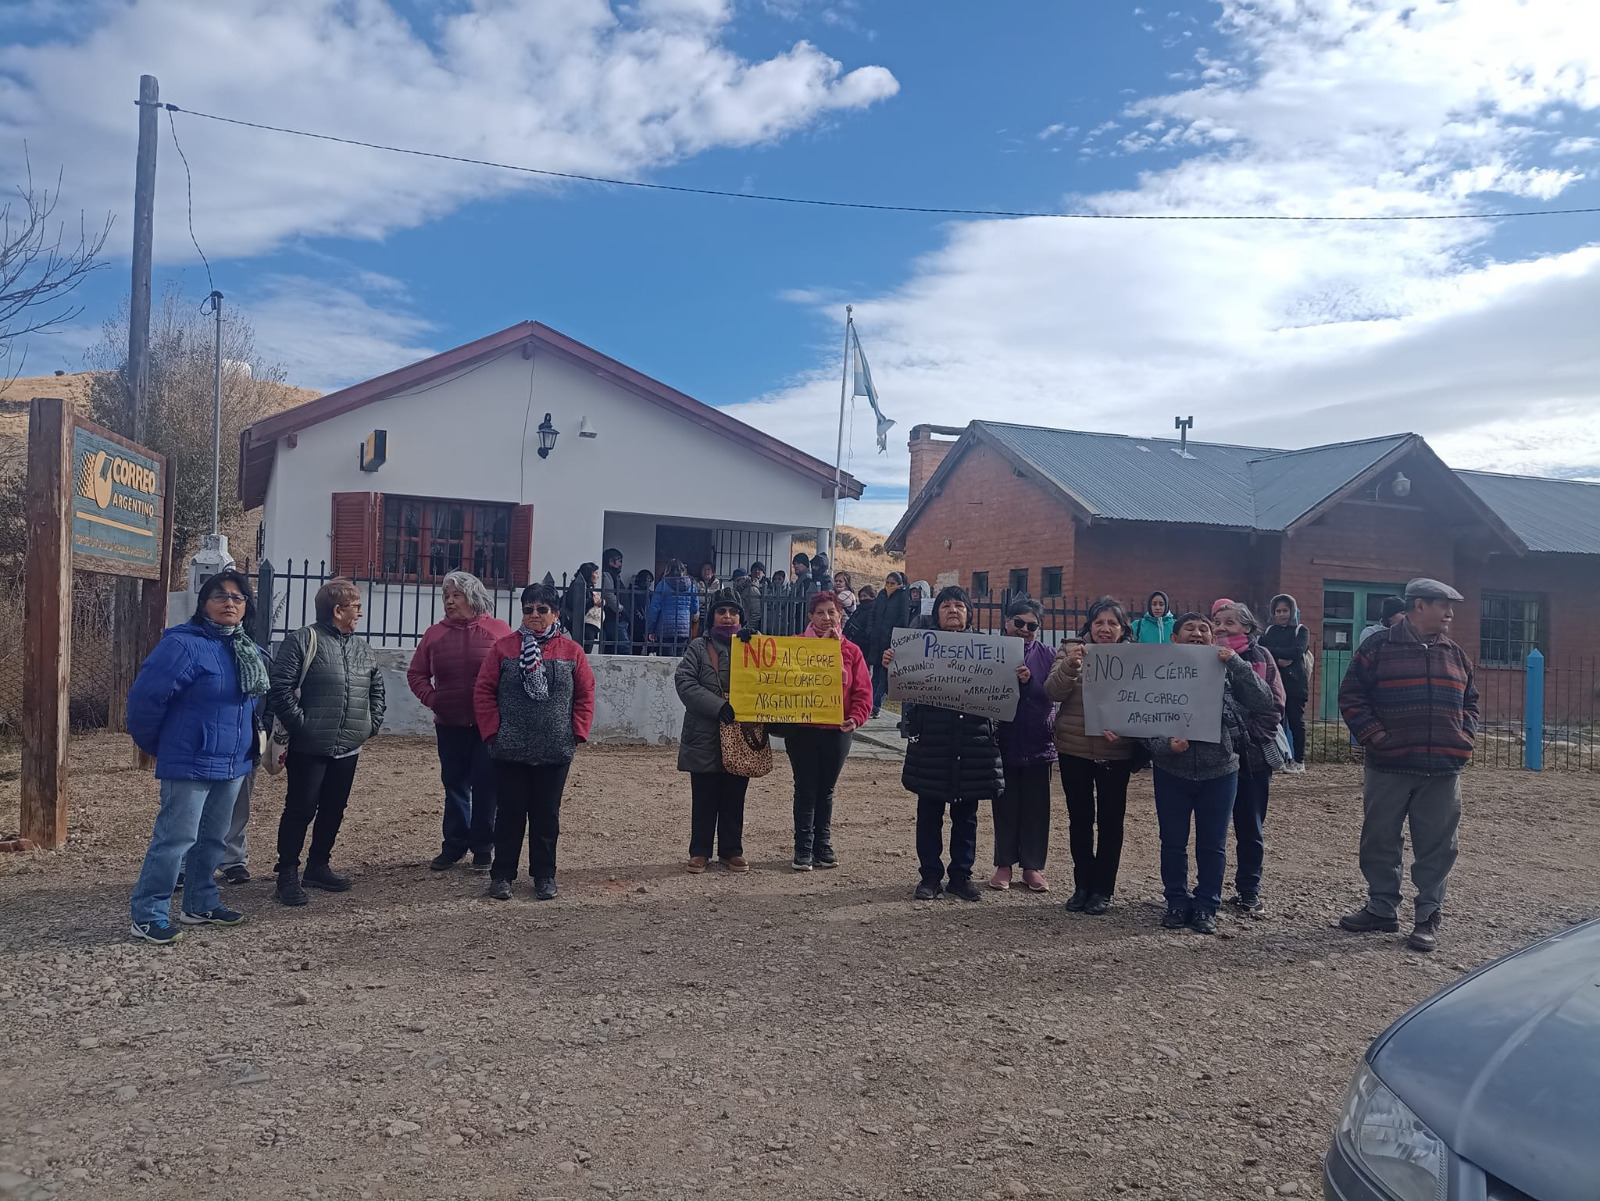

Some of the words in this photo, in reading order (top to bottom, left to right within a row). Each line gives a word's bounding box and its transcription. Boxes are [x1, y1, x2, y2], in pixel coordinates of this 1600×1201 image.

[113, 456, 156, 495] CORREO
[113, 493, 154, 517] ARGENTINO
[743, 637, 776, 668] NO
[796, 646, 835, 667] CIERRE
[756, 670, 782, 686] DEL
[784, 669, 833, 688] CORREO
[969, 665, 994, 676] CHICO
[1131, 662, 1147, 681] AL
[1117, 689, 1140, 703] DEL
[1144, 692, 1189, 706] CORREO
